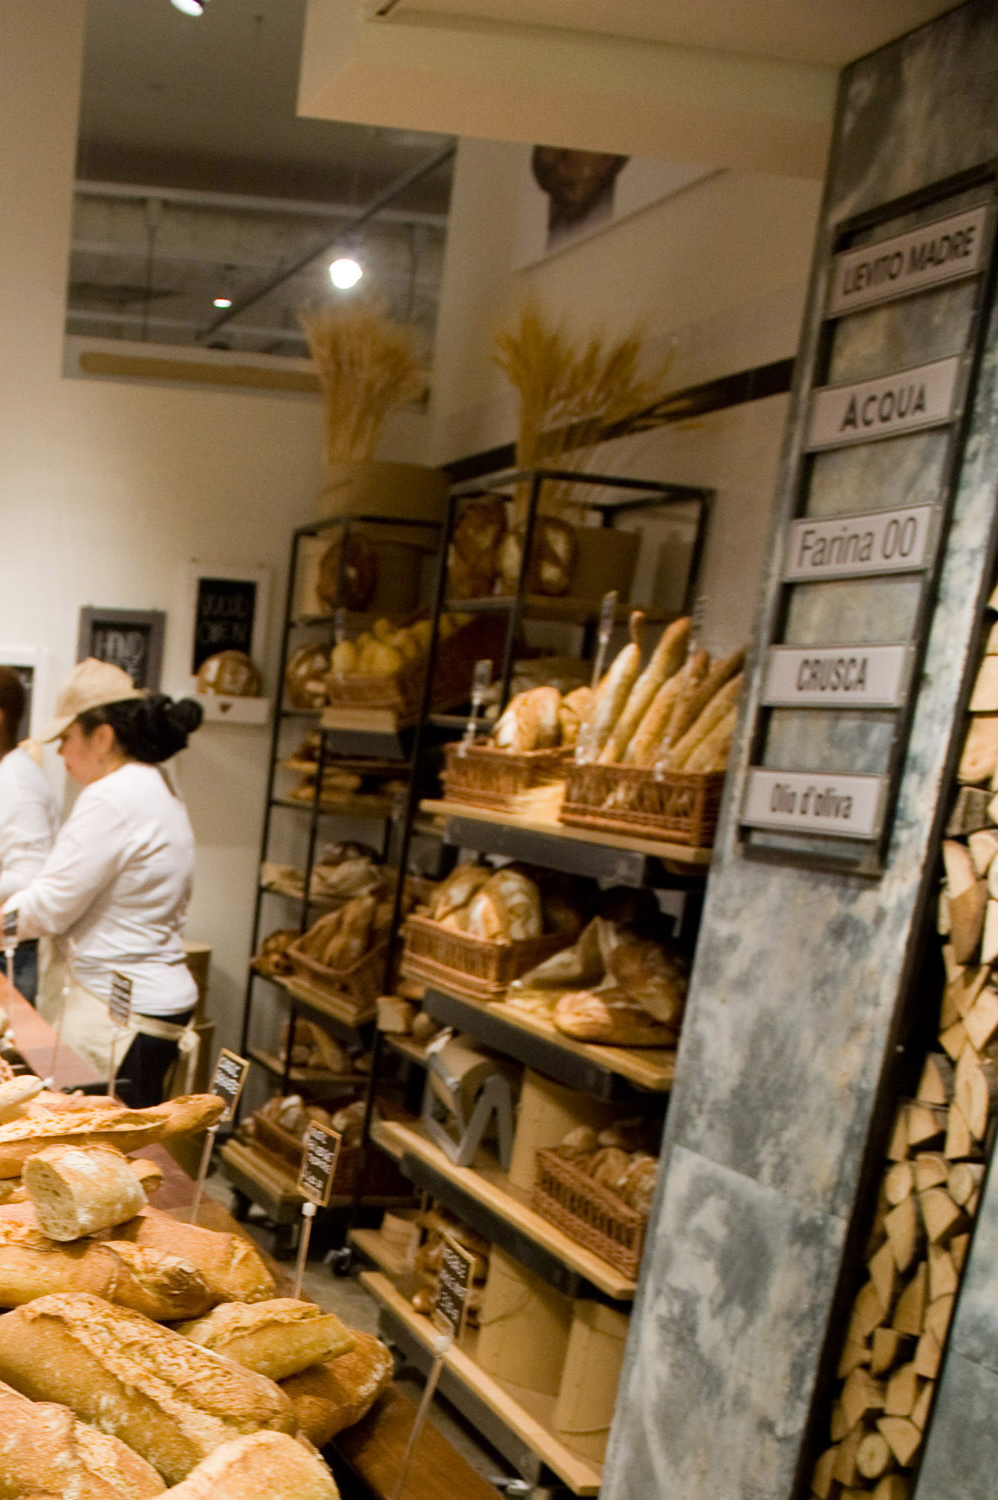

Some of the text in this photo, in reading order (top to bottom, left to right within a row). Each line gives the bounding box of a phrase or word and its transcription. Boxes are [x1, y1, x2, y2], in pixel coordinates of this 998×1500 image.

[842, 225, 977, 296] LIEVITO MADRE
[838, 384, 927, 432] ACQUA
[797, 516, 918, 568] Farina 00
[796, 656, 869, 693] CRUSCA
[770, 783, 854, 820] Olio d'oliva
